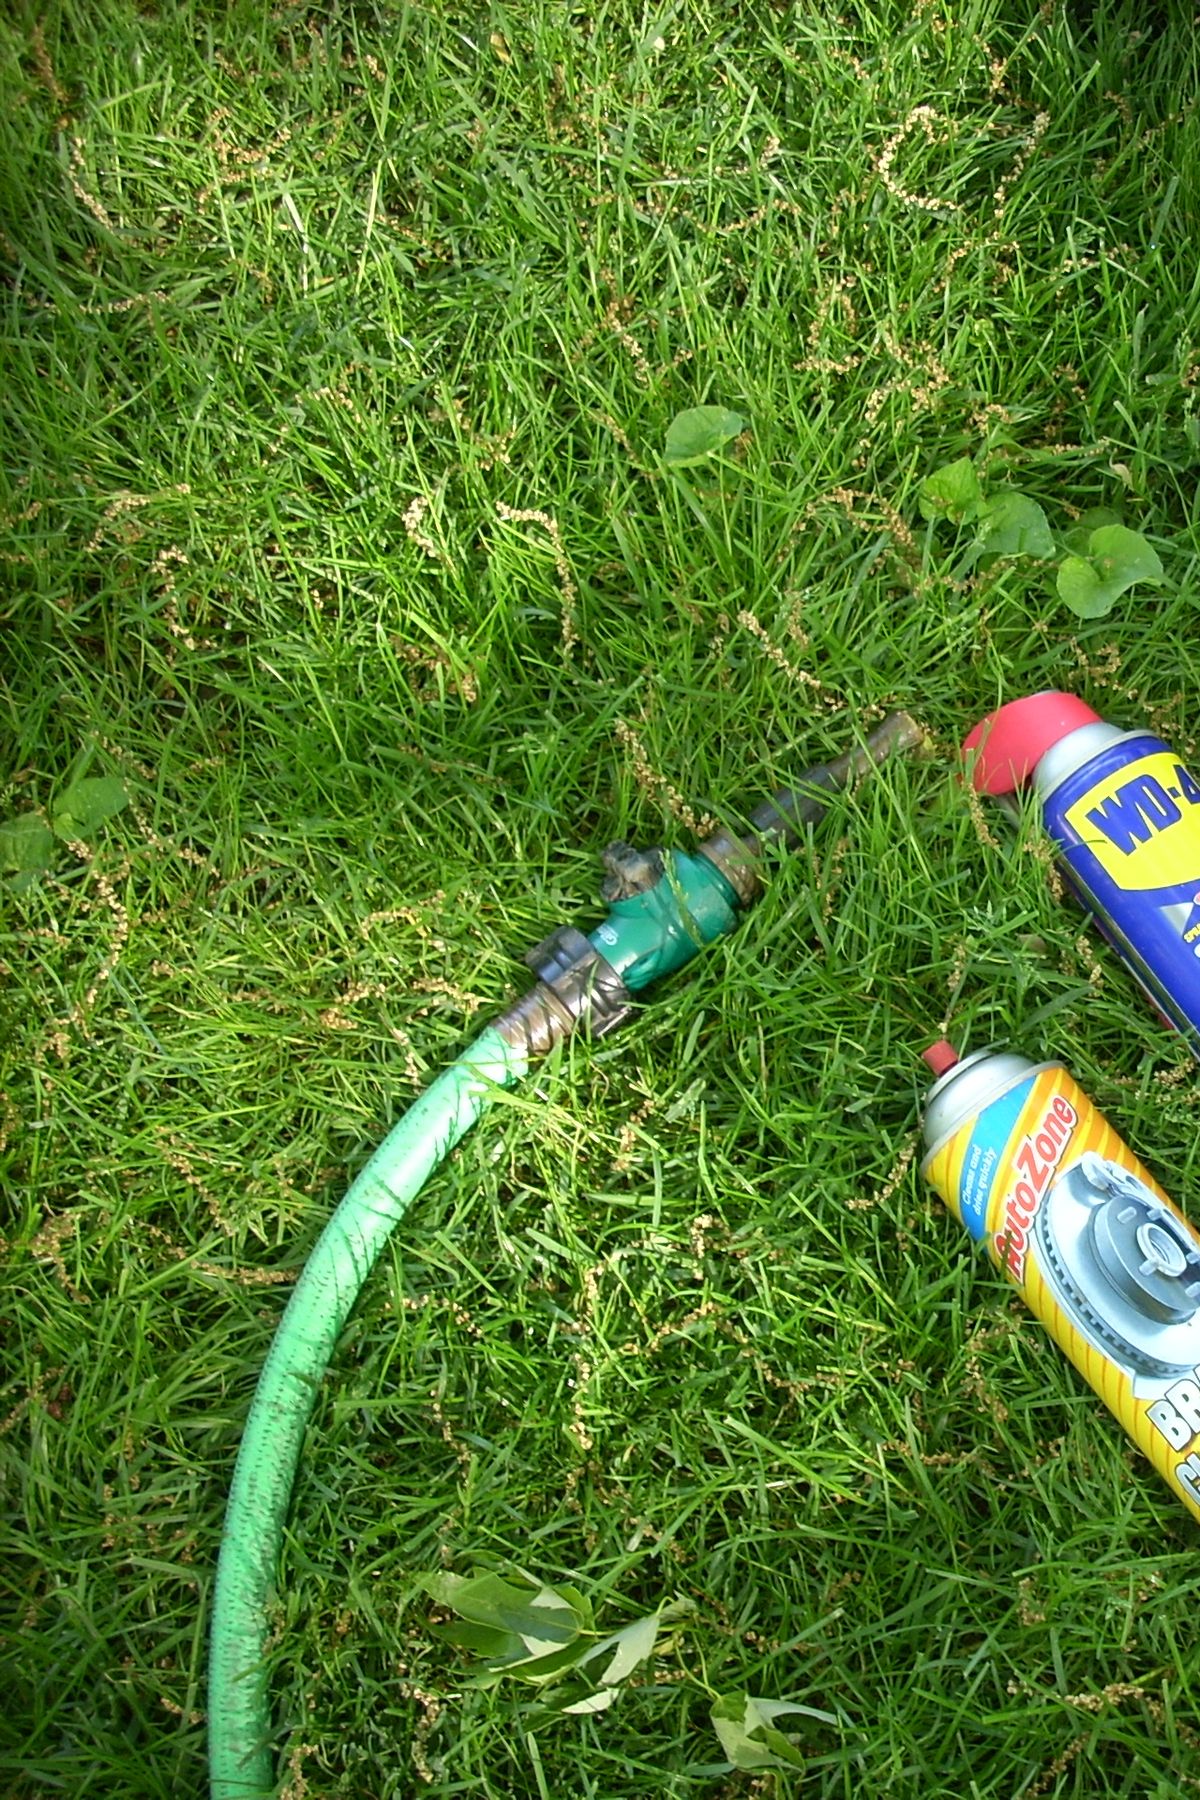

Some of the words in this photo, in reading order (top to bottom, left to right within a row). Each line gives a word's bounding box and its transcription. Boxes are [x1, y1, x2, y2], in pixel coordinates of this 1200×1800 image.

[962, 1172, 976, 1205] Cleans
[970, 1144, 982, 1171] and
[977, 1146, 998, 1190] quickly
[995, 1096, 1077, 1279] AutoZone
[972, 1189, 984, 1216] dries
